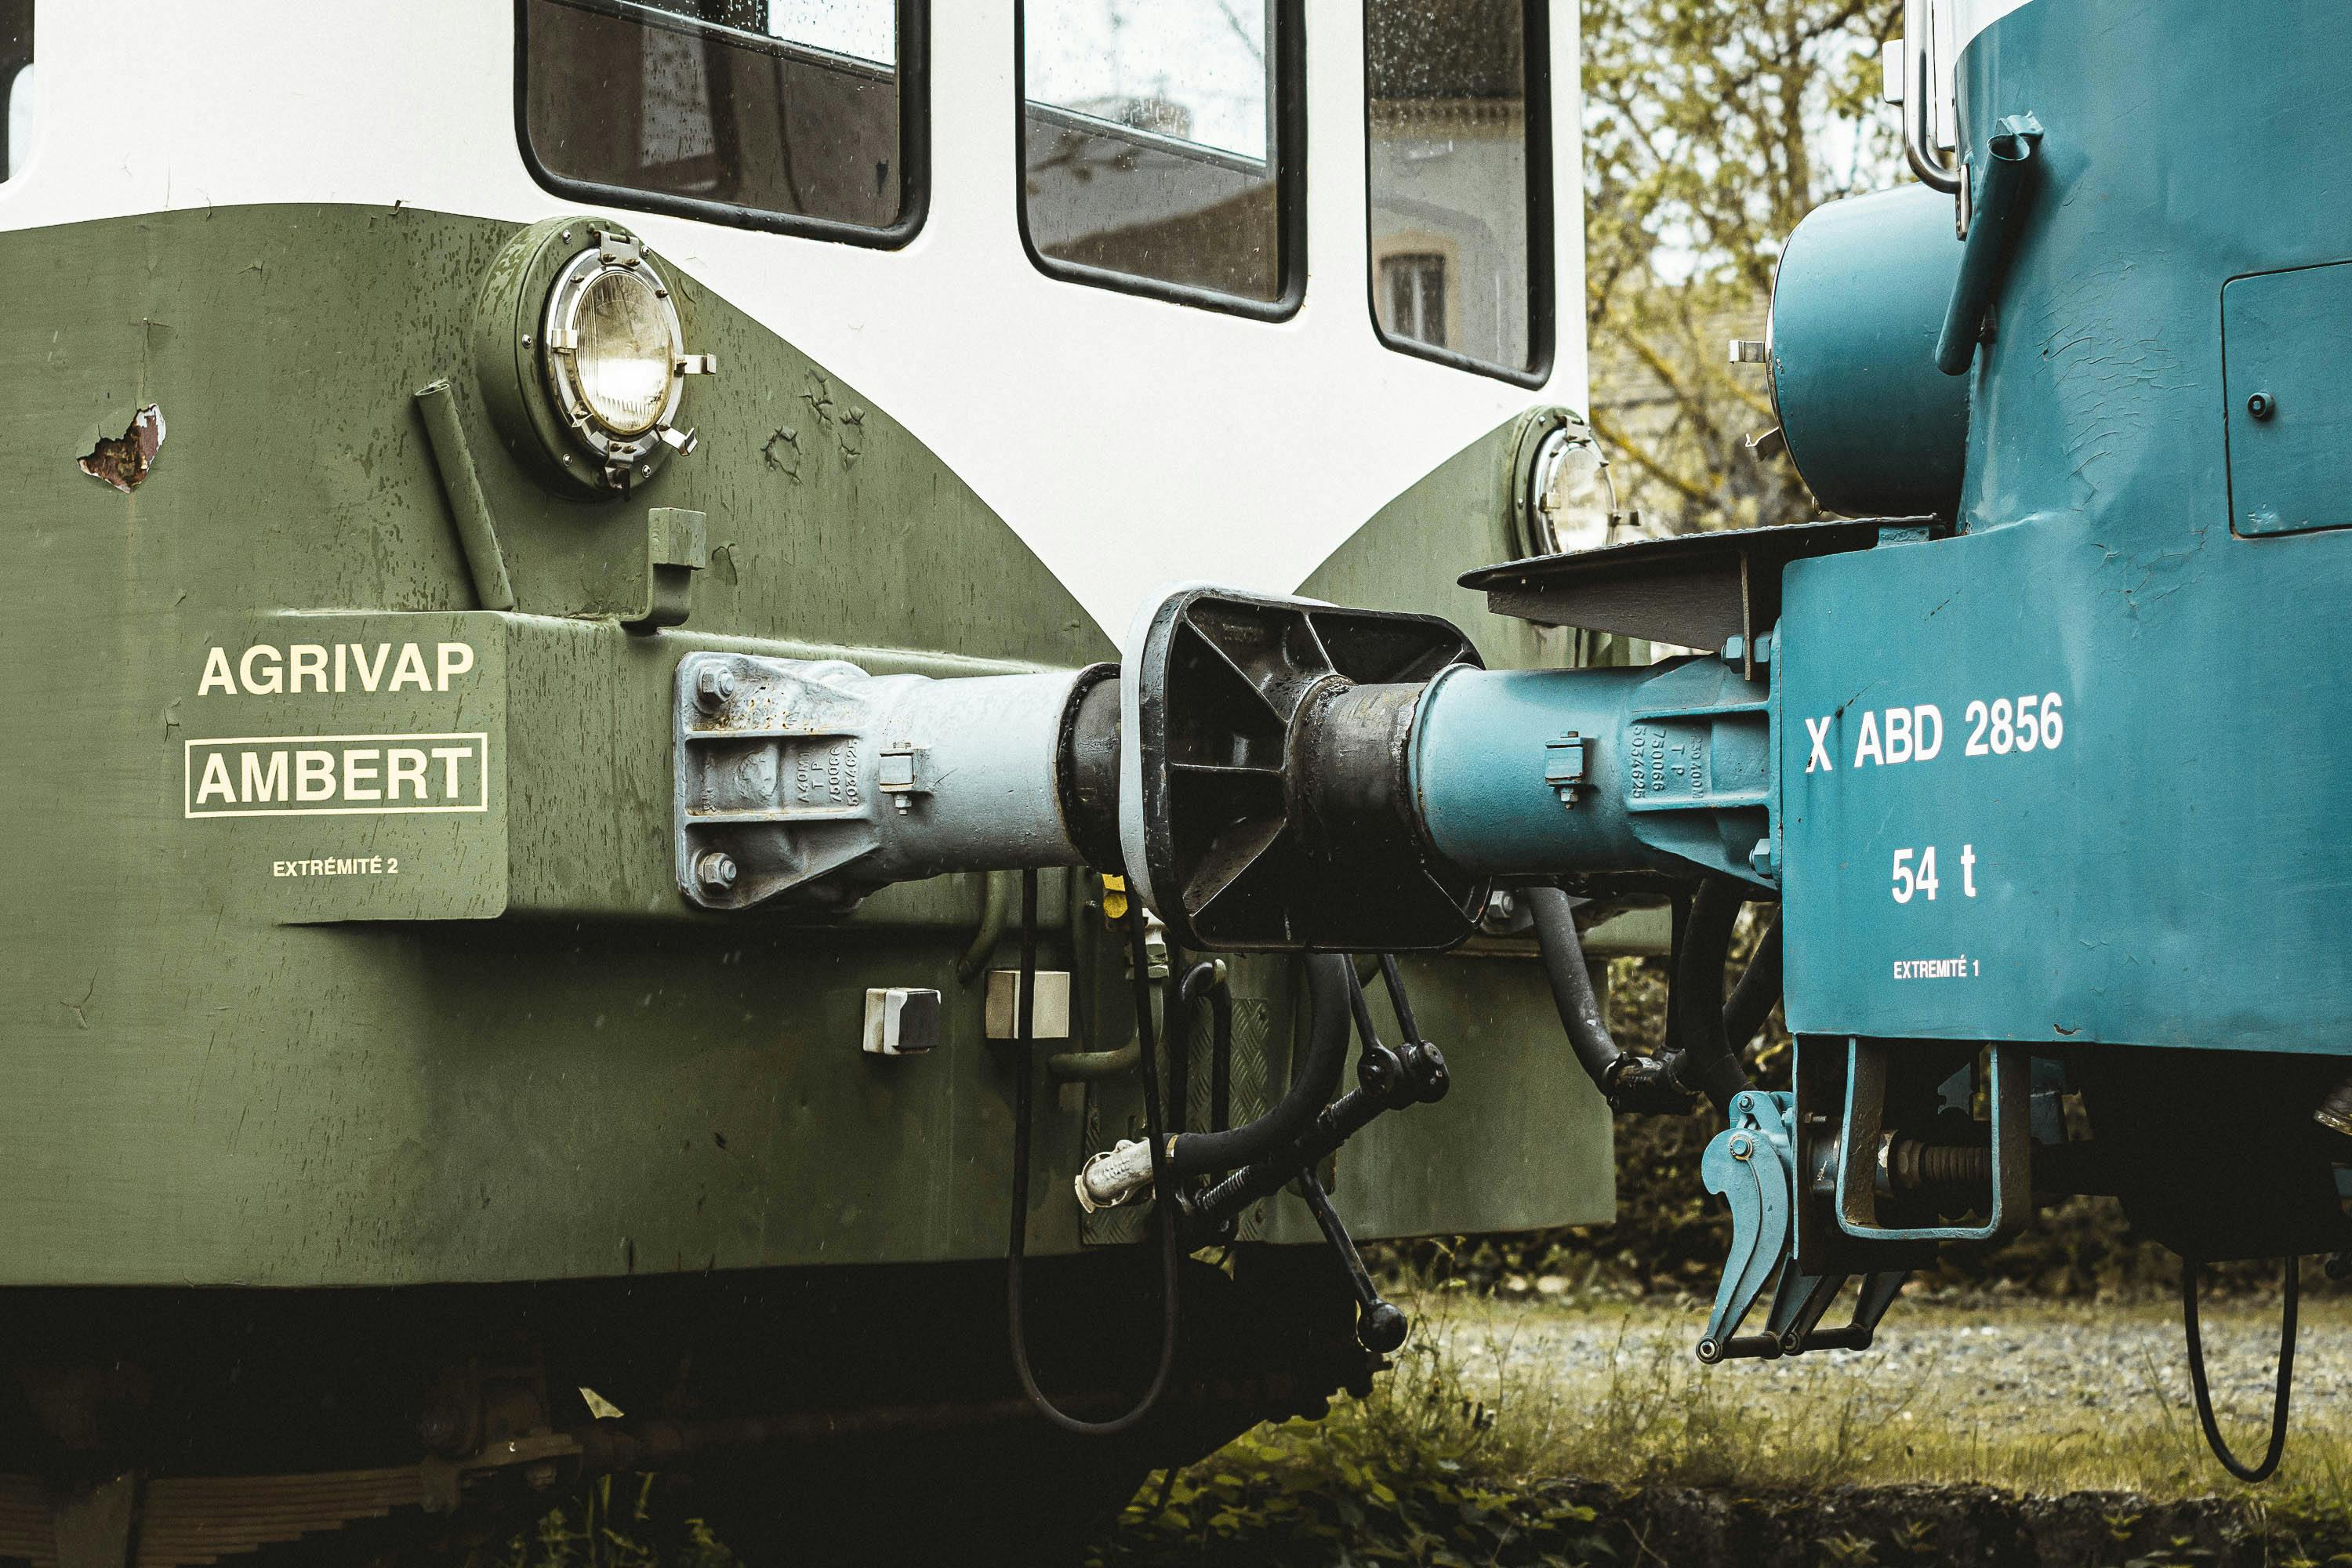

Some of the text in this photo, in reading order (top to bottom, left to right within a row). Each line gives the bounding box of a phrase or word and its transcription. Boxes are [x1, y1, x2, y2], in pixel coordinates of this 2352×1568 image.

[198, 642, 474, 696] AGRIVAP
[1651, 729, 1667, 791] 750066
[1805, 691, 2063, 773] X ABD 2856
[196, 747, 473, 804] AMBERT
[828, 746, 842, 802] 750066
[1631, 726, 1646, 798] 5034625
[273, 855, 398, 877] EXTRÉMITÉ 2
[1892, 844, 1976, 904] 54 t
[1973, 959, 1980, 977] 1
